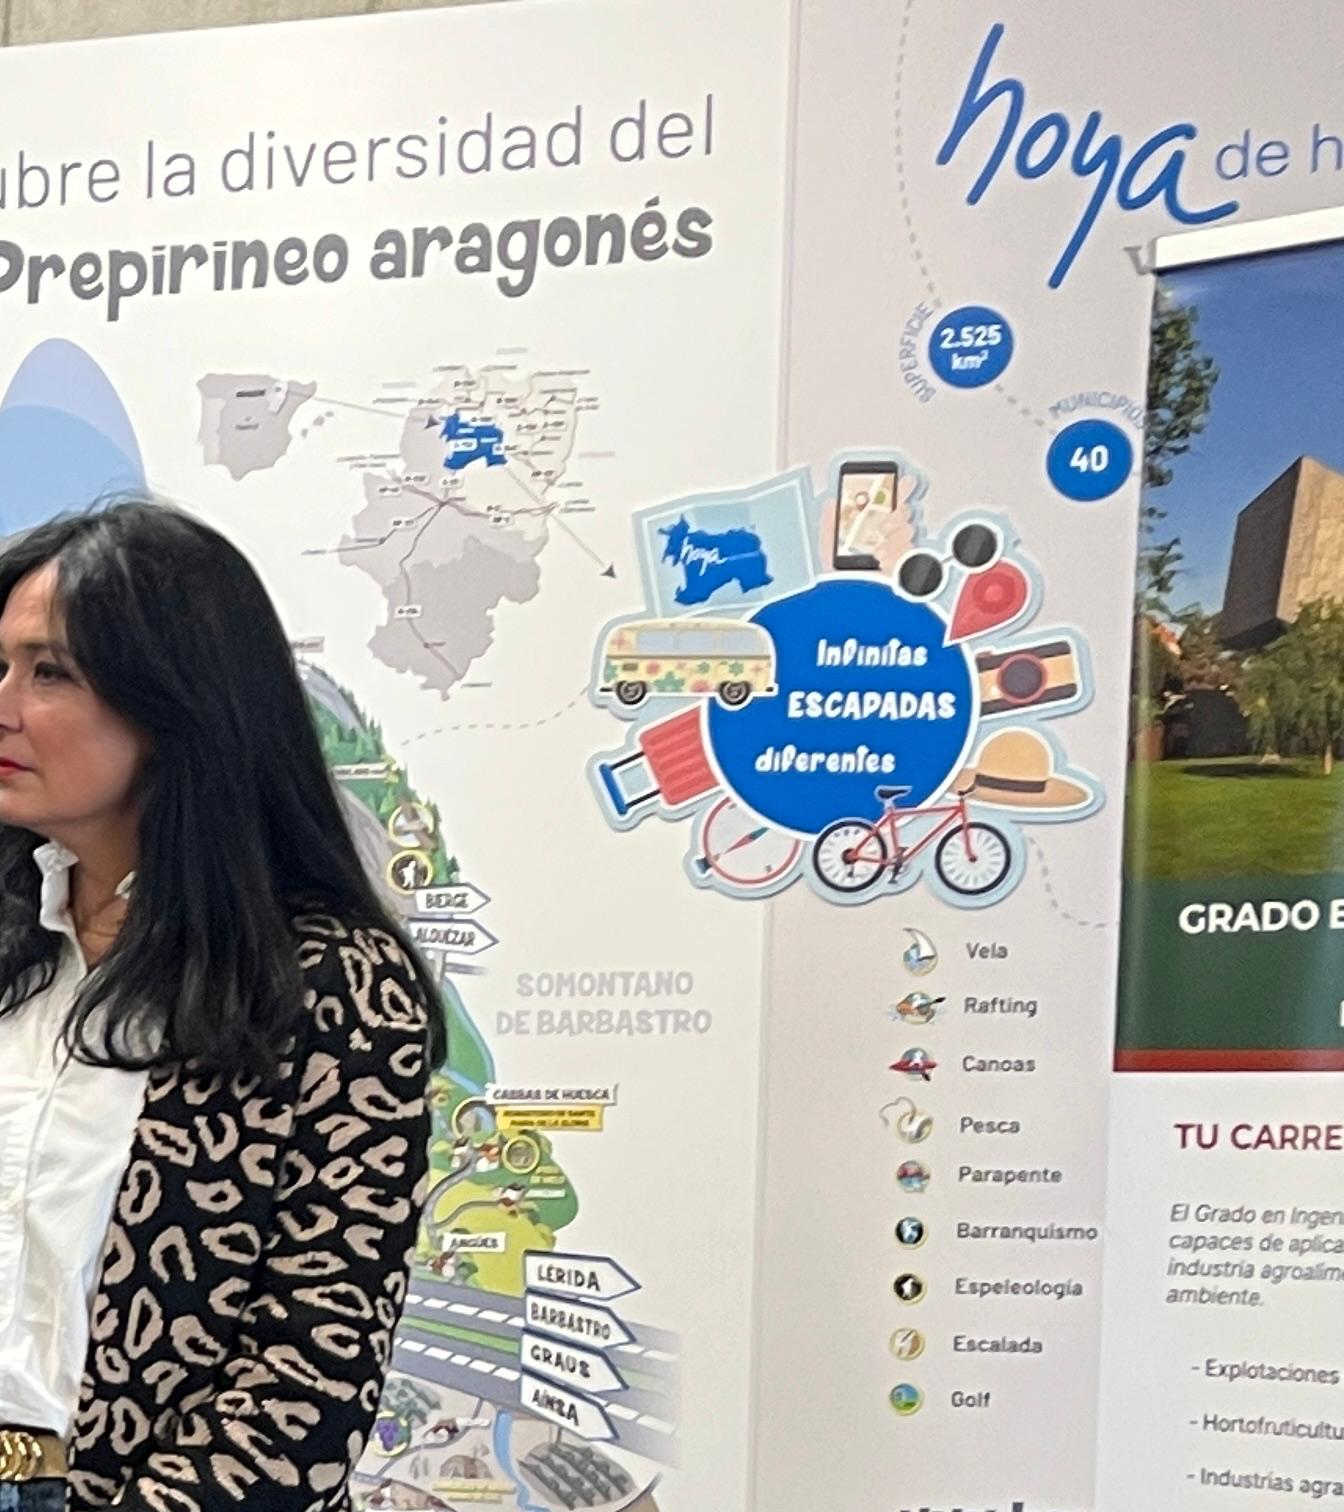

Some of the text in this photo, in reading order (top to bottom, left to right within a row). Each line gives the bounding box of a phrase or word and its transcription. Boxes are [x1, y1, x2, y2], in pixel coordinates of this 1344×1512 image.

[143, 138, 196, 200] la
[220, 104, 584, 195] diversidad
[609, 93, 715, 163] del
[936, 23, 1239, 289] hoya
[1214, 129, 1291, 180] de
[369, 194, 714, 297] aragonés
[939, 324, 1003, 349] 2.525
[1070, 445, 1109, 473] 40
[816, 639, 928, 667] Infinitas
[787, 690, 957, 721] ESCAPADAS
[755, 744, 897, 775] diferentes
[1179, 900, 1319, 934] GRADO
[966, 942, 1008, 960] Vela
[517, 971, 694, 997] SOMONTANO
[963, 997, 1038, 1018] Rafting
[496, 1009, 713, 1037] DE BARBASTRO
[962, 1055, 1037, 1073] Canoas
[960, 1116, 1020, 1135] Pesca
[1174, 1123, 1344, 1150] TU CARRE
[958, 1166, 1062, 1187] Parapente
[1170, 1203, 1190, 1222] El
[1195, 1203, 1257, 1224] Grado
[1261, 1209, 1285, 1224] en
[957, 1222, 1099, 1243] Barranquismo
[1169, 1235, 1254, 1254] capaces
[1259, 1233, 1284, 1251] de
[1166, 1257, 1255, 1279] industria
[955, 1277, 1084, 1301] Espeleología
[1166, 1286, 1264, 1307] ambiente.
[531, 1302, 611, 1341] BARBASTRO
[953, 1335, 1043, 1354] Escalada
[530, 1345, 591, 1379] GRAUS
[1204, 1358, 1340, 1384] Explotaciones
[951, 1390, 991, 1408] Golf
[1200, 1467, 1293, 1493] Industrias
